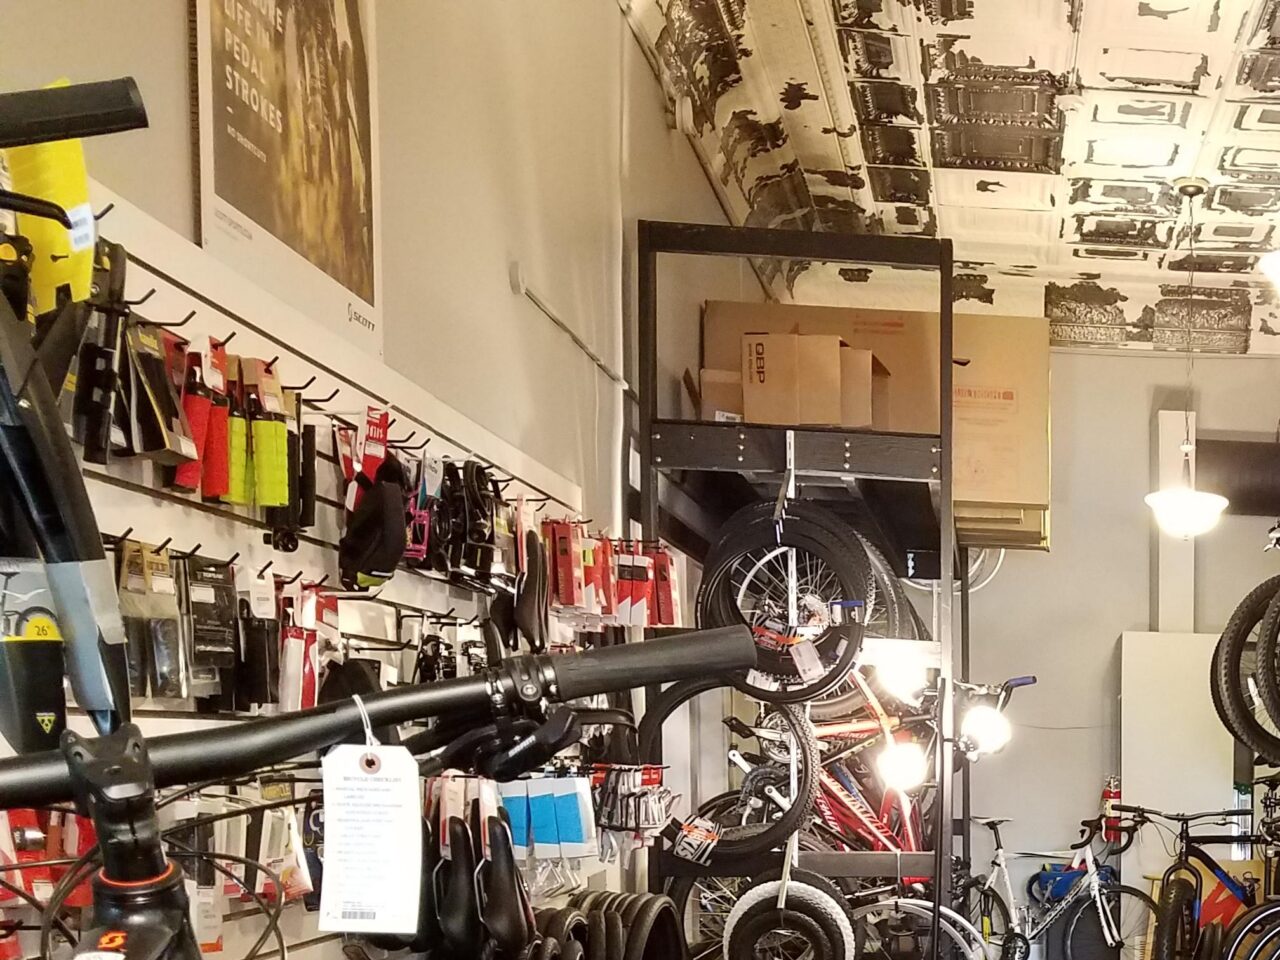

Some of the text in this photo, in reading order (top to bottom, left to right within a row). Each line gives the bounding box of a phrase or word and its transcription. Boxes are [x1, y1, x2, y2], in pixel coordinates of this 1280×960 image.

[224, 26, 267, 85] PEDAL
[225, 64, 283, 134] STROKES
[353, 311, 375, 332] SCOTT
